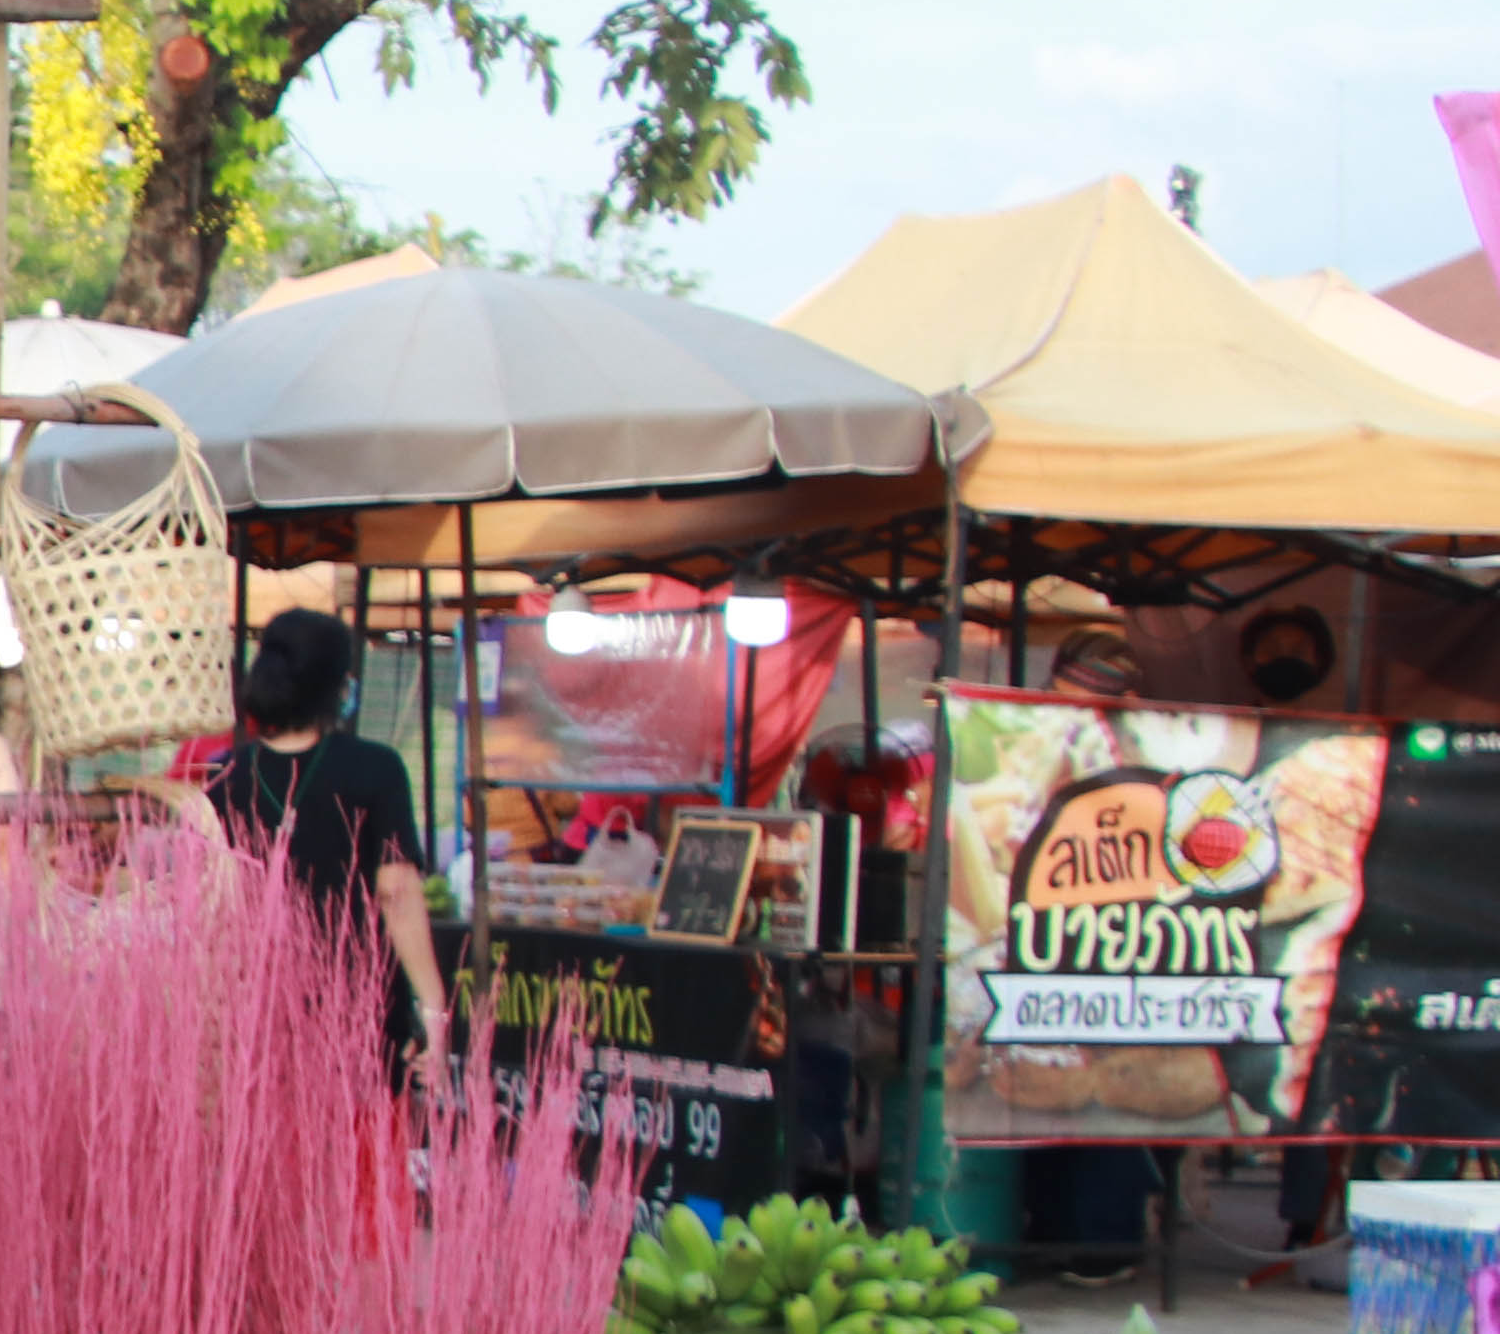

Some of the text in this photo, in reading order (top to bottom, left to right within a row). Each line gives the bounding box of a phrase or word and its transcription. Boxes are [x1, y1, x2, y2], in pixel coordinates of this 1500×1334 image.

[1047, 803, 1151, 889] สเต็ก
[1010, 883, 1258, 974] บายภัทร
[687, 1099, 721, 1160] 99
